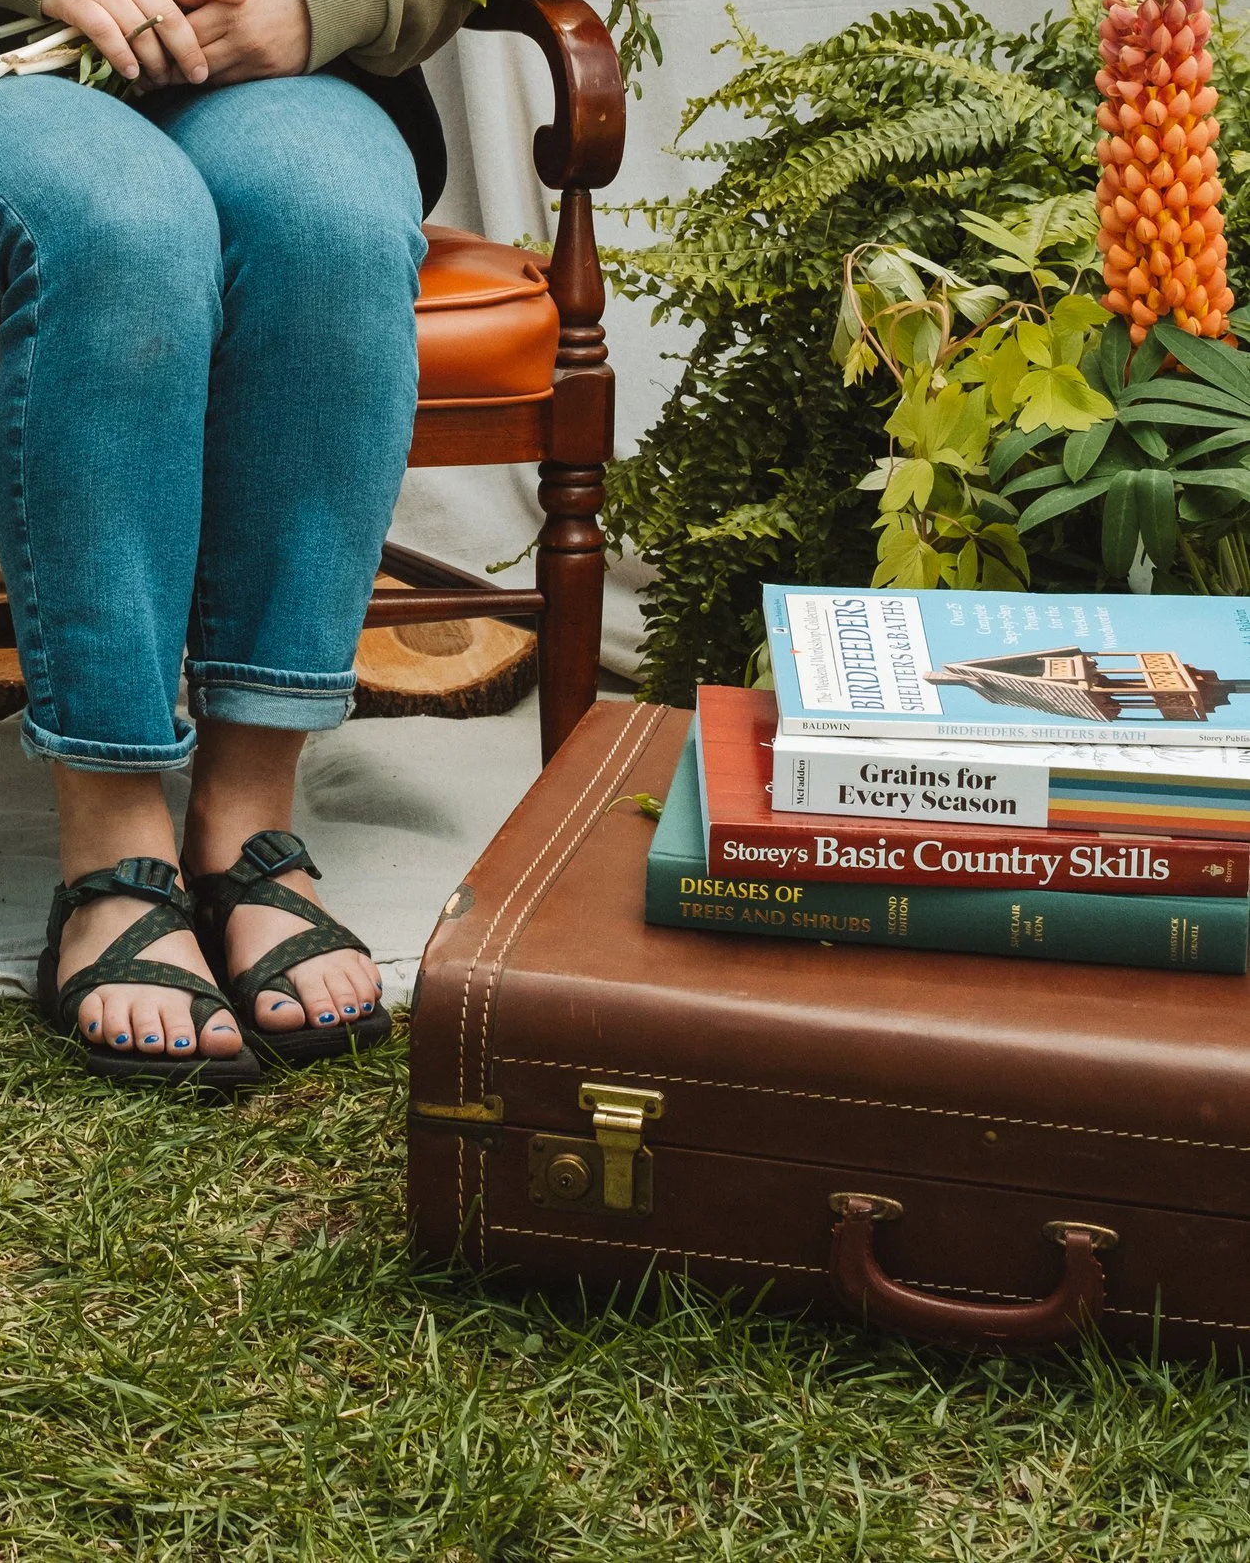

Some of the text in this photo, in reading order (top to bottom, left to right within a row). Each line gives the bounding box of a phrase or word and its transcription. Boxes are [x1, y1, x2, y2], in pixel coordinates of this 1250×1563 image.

[880, 600, 909, 640] BATHS
[832, 599, 885, 710] BIRDFEEDERS
[891, 653, 925, 711] SHELTERS
[802, 722, 851, 731] BALDWIN
[937, 725, 1026, 739] BIRDFEEDERS,
[1031, 728, 1095, 740] SHELTERS
[1098, 730, 1109, 740] &
[1199, 734, 1223, 743] Storey
[796, 759, 806, 805] McFadden
[860, 763, 997, 790] Grains for
[838, 784, 1017, 815] Every Season
[723, 836, 1170, 886] Storey's Basic Country Skills
[1225, 858, 1235, 883] Storey
[680, 877, 804, 904] DISEASES OF
[679, 901, 872, 933] TREES AND SHRUBS
[887, 896, 898, 935] SECOND
[899, 897, 909, 936] EDITION
[1010, 904, 1022, 949] SINCLAIR
[1024, 921, 1032, 936] and
[1034, 916, 1044, 942] LYON
[1170, 917, 1179, 962] COMSTOCK
[1191, 924, 1199, 960] CORNELL
